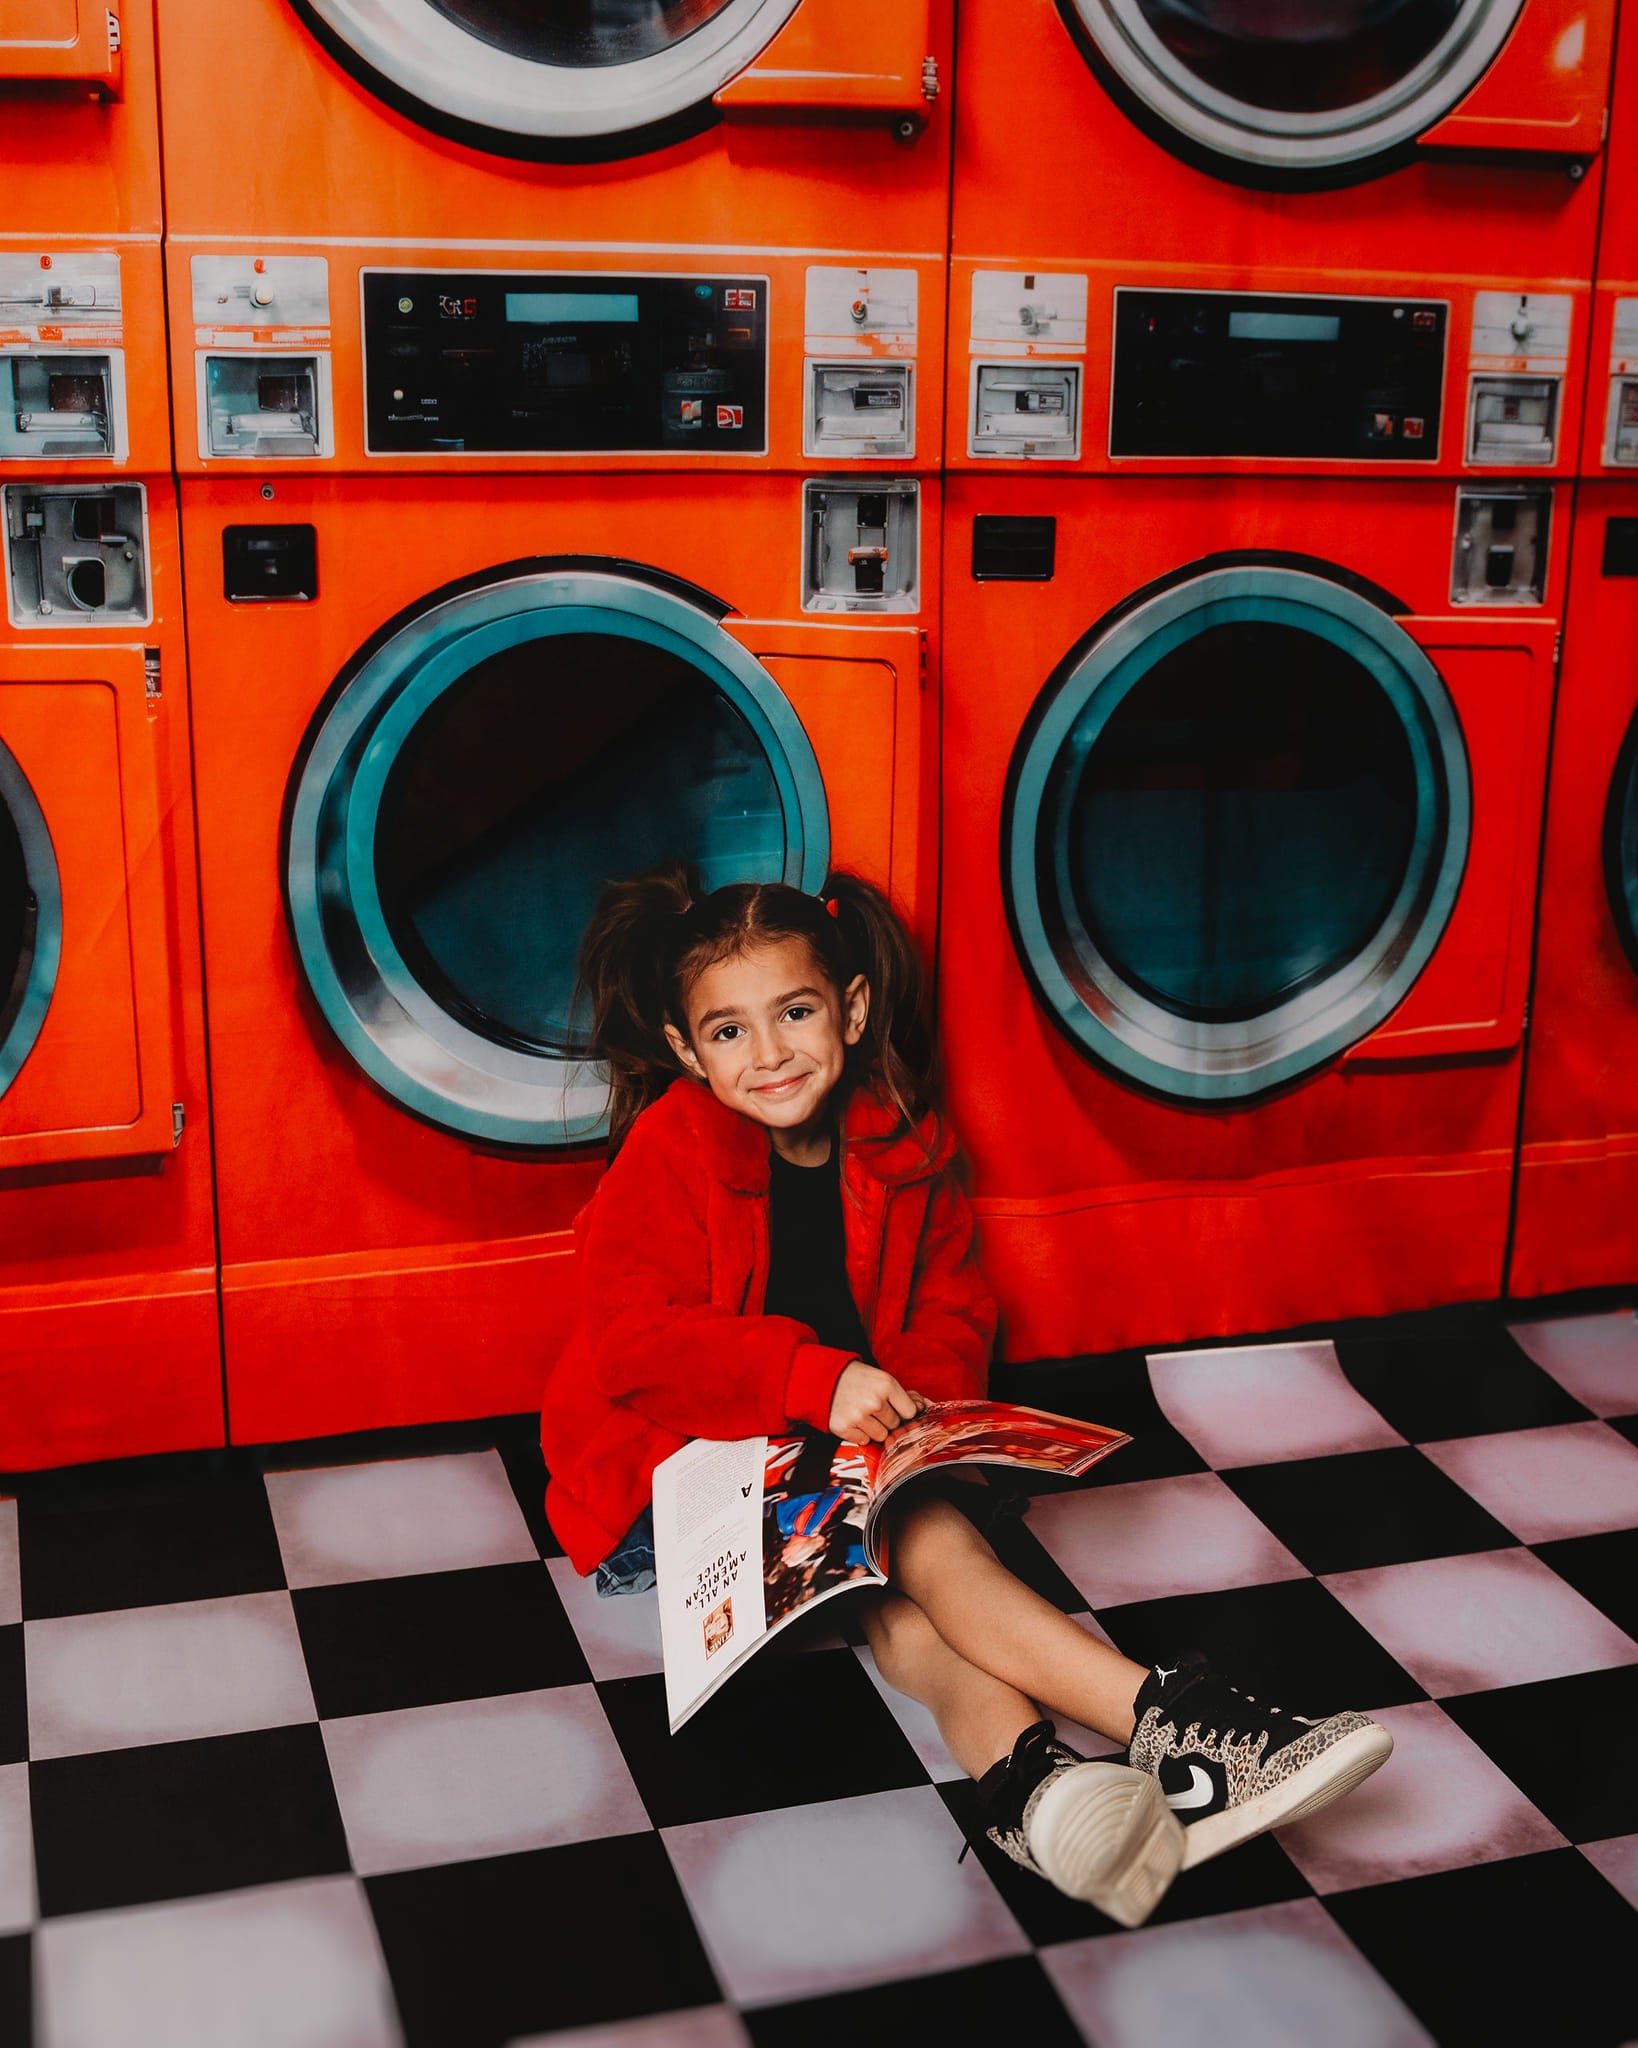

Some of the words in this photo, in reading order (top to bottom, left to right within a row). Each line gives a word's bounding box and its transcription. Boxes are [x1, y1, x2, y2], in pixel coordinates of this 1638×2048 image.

[741, 1483, 753, 1498] A
[685, 1550, 748, 1609] AMERICAN
[696, 1549, 732, 1585] VOICE
[722, 1569, 738, 1589] AN
